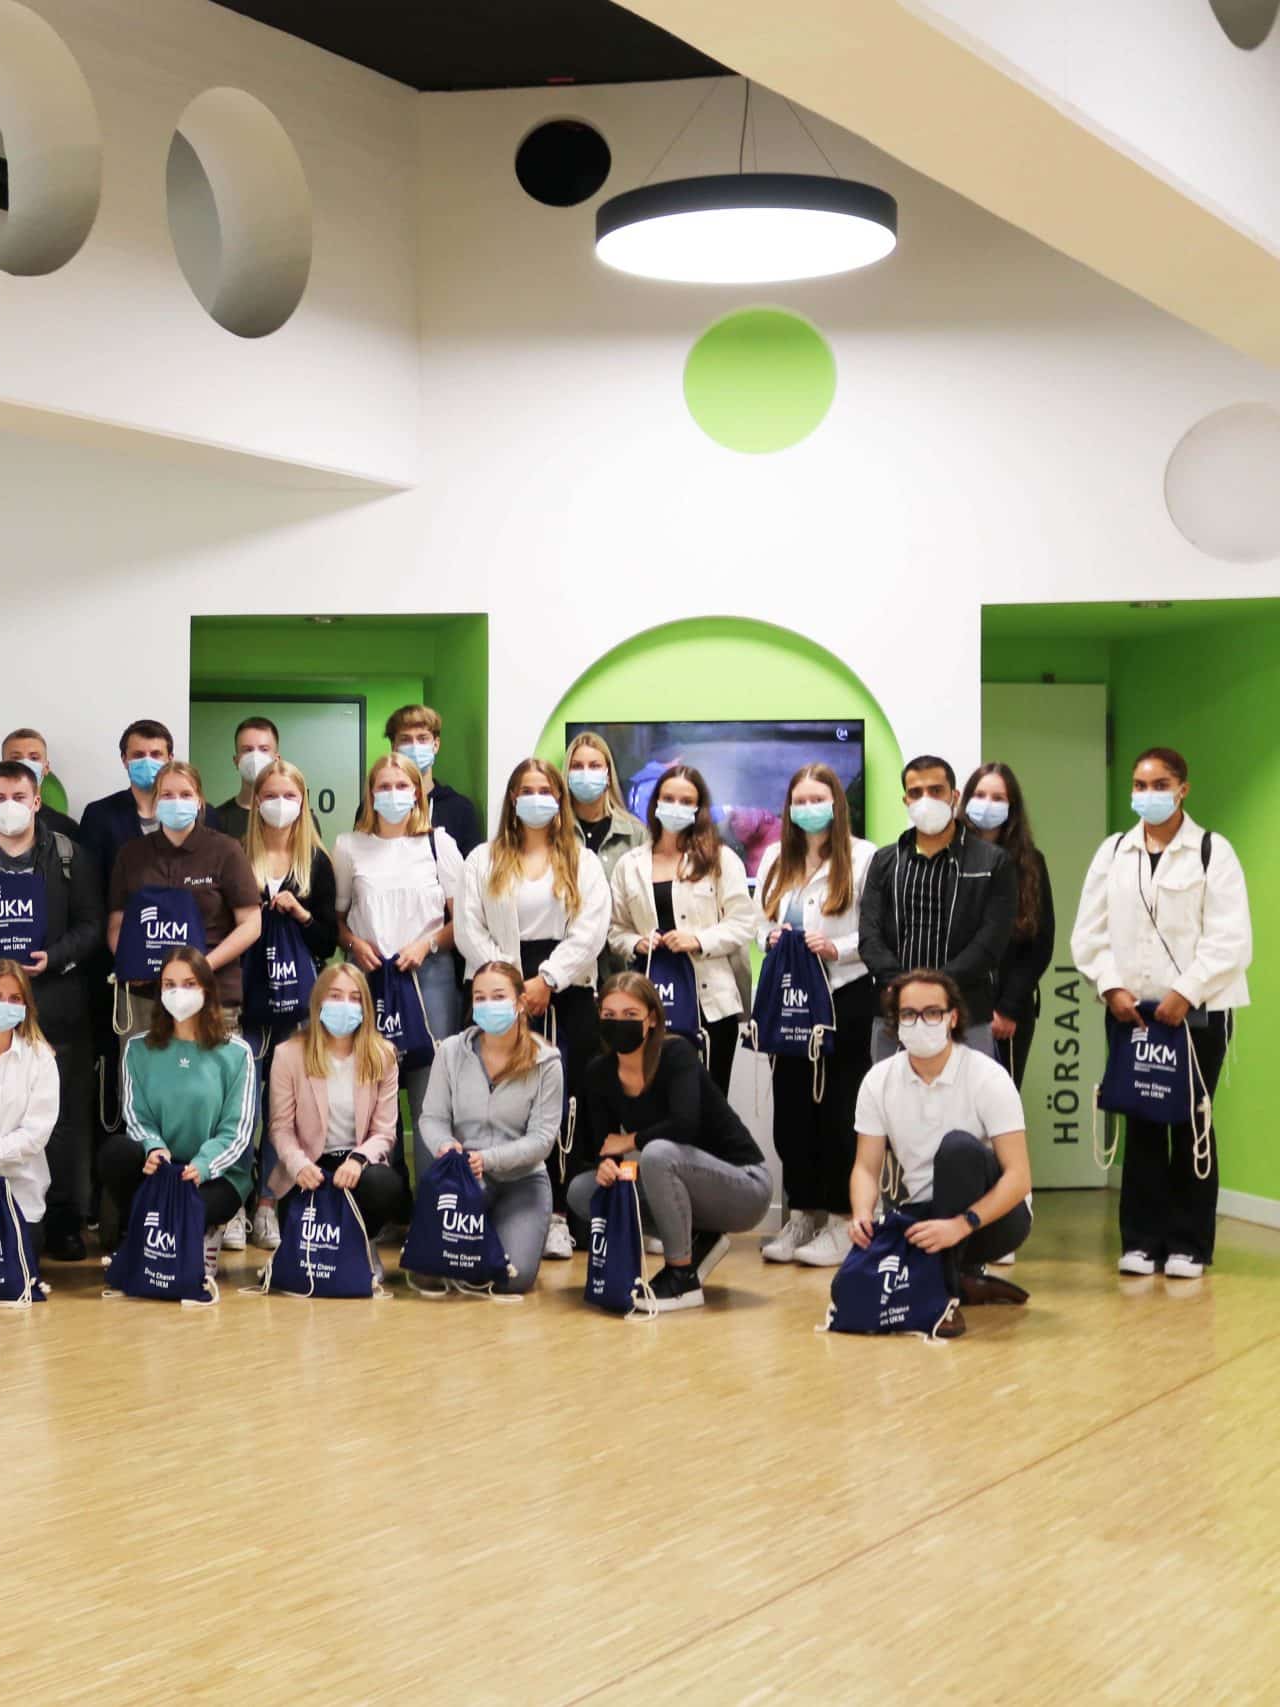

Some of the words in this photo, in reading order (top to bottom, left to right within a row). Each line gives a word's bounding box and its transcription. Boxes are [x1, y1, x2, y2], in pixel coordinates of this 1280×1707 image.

[146, 921, 188, 940] UKM
[267, 960, 297, 980] UKM
[1135, 1042, 1177, 1067] UKM
[302, 1222, 341, 1244] UKM
[442, 1210, 484, 1235] UKM
[146, 1227, 176, 1252] UKM
